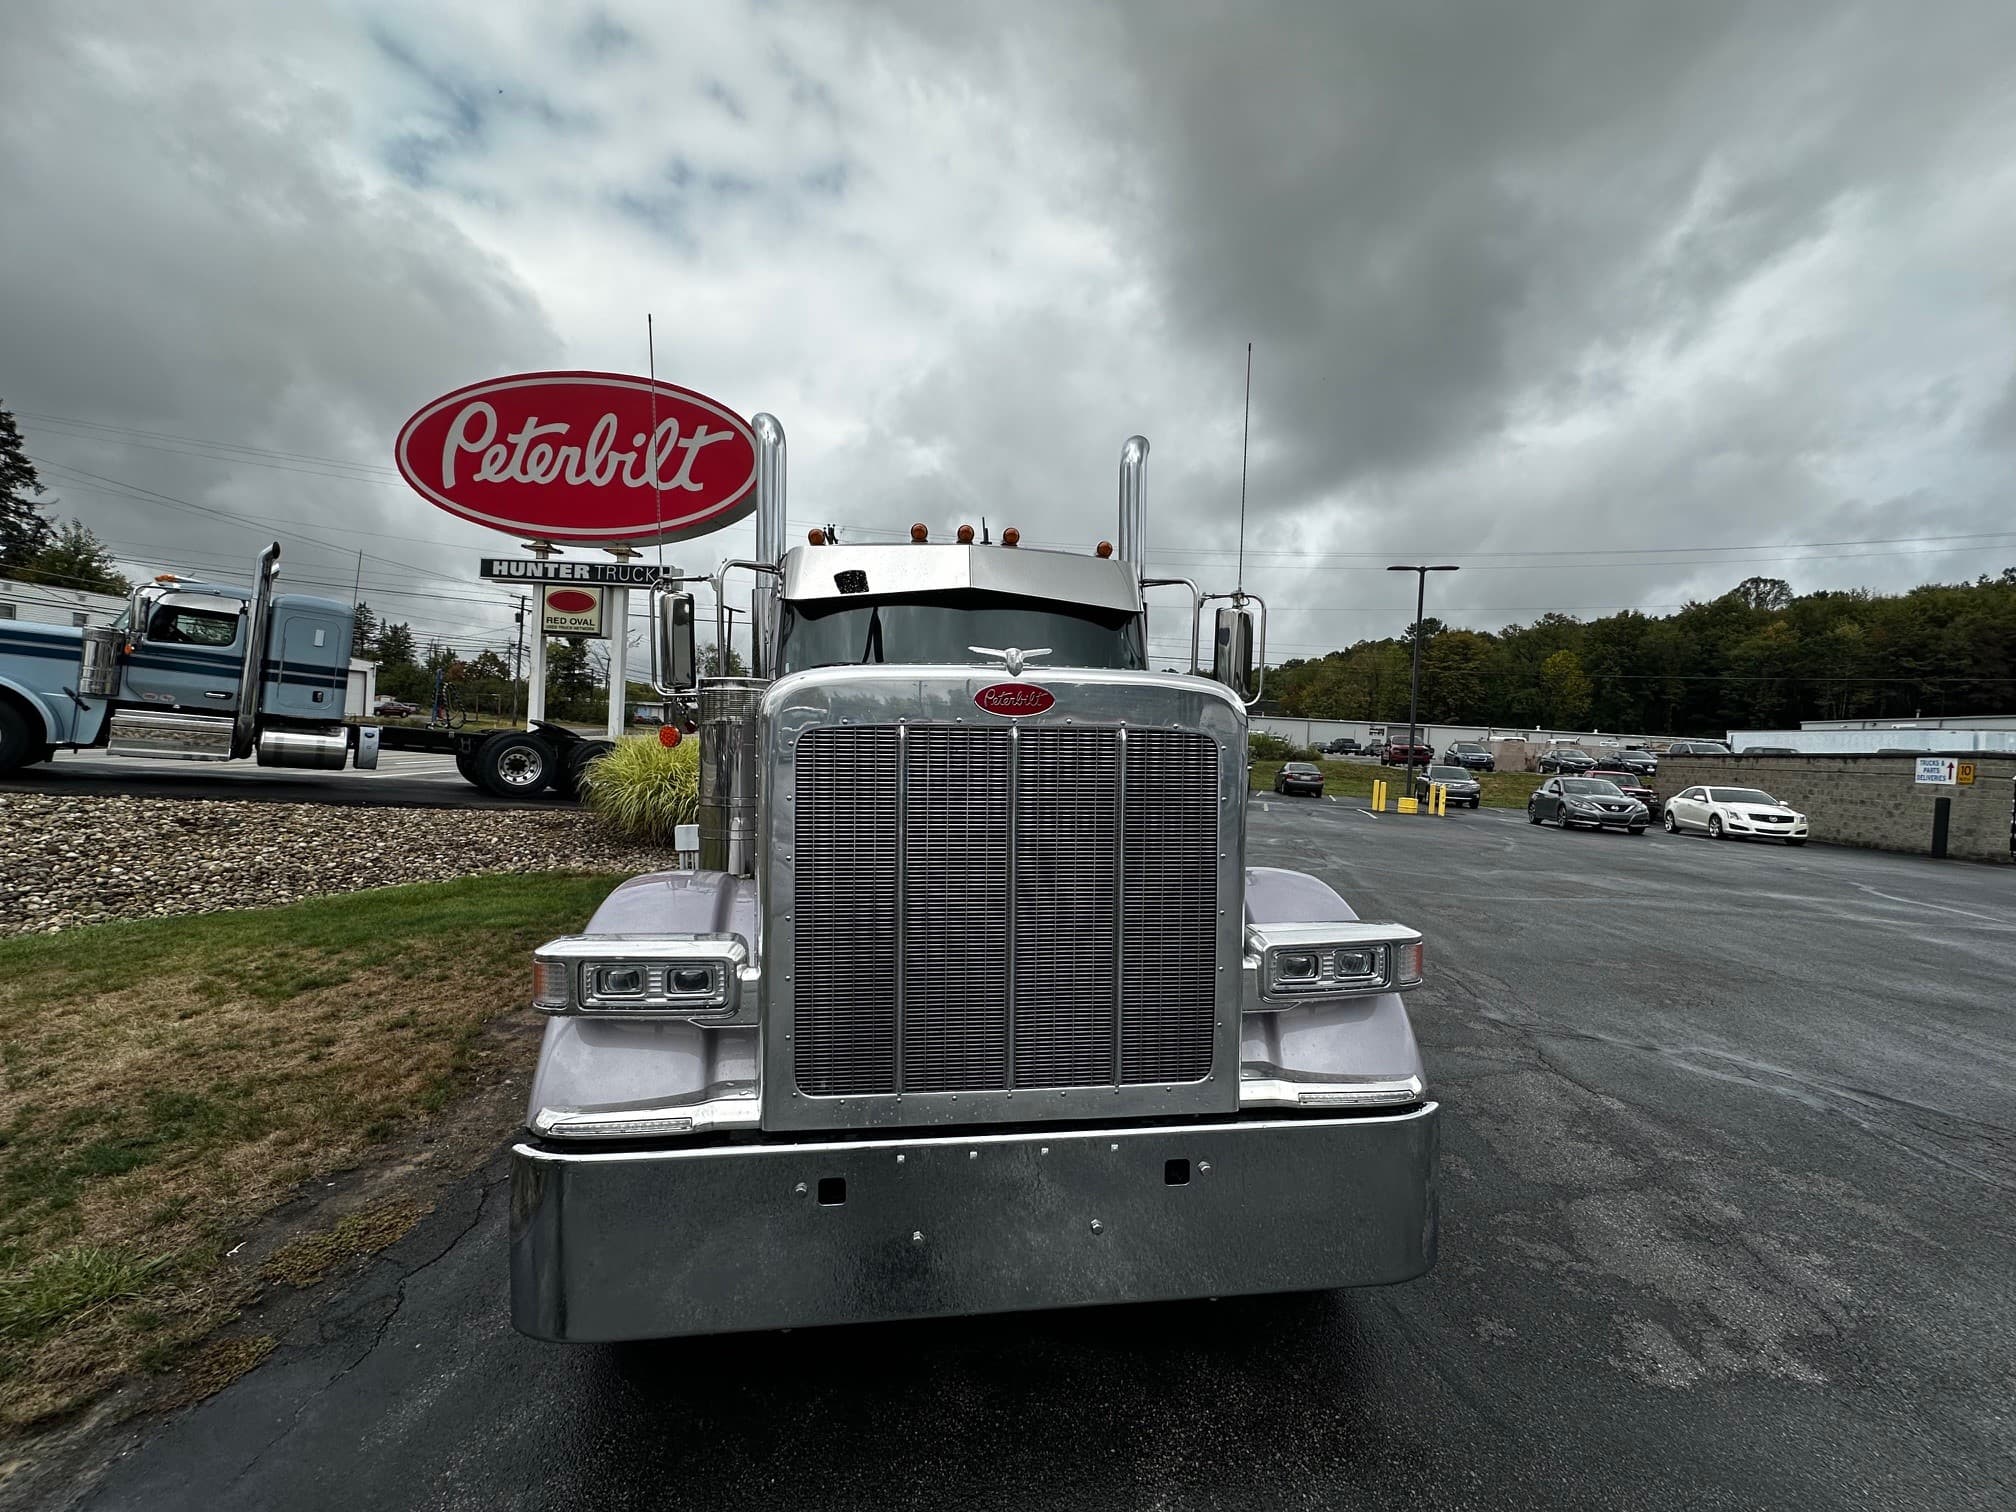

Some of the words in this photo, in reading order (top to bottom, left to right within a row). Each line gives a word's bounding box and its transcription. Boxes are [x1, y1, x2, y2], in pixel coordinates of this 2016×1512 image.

[442, 401, 735, 492] Peterbilt
[492, 560, 590, 579] HUNTER
[546, 616, 567, 625] RED
[569, 617, 595, 626] OVAL
[984, 688, 1048, 707] Peterbilt
[1961, 765, 1971, 776] 10
